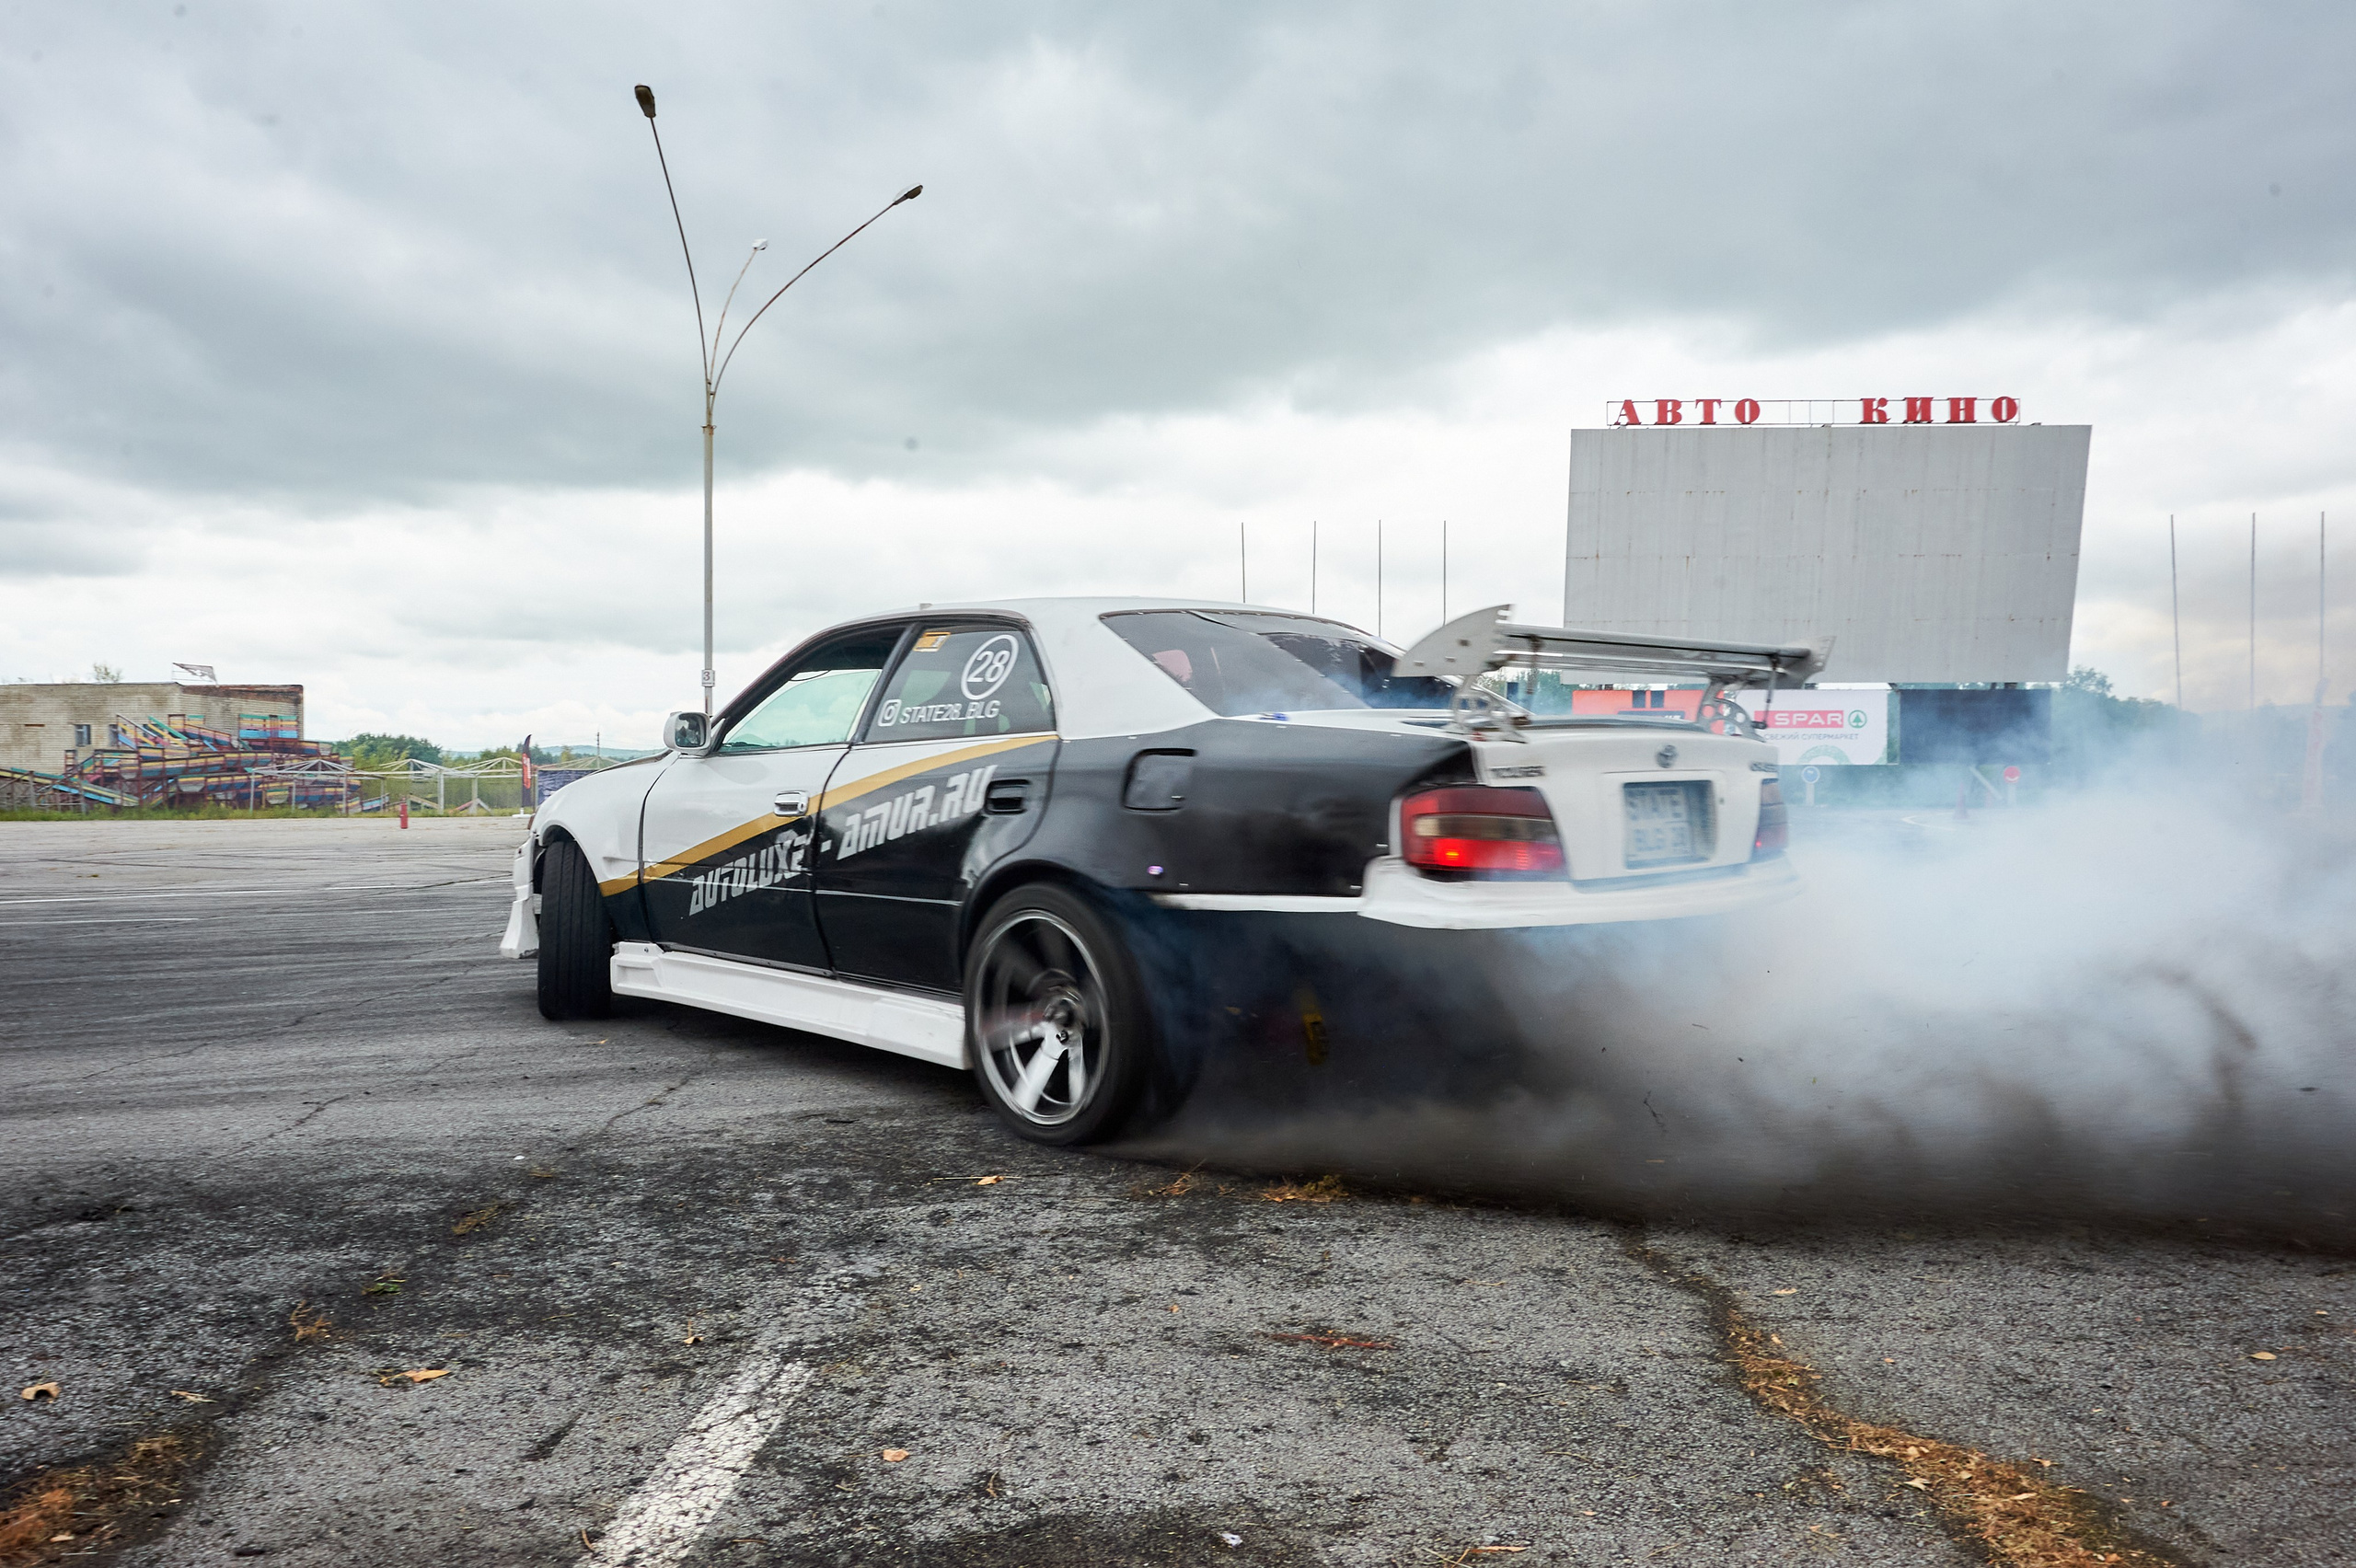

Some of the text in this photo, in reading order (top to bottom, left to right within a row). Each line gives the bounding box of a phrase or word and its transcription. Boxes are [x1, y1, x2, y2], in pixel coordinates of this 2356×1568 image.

[1614, 396, 2020, 426] АВТО КИНО
[967, 650, 1011, 683] 28
[899, 699, 1001, 724] STATE28_BLG
[1774, 712, 1842, 726] SPAR
[1764, 732, 1859, 741] СВЕЖИЙ СУПЕРМАРКЕТ
